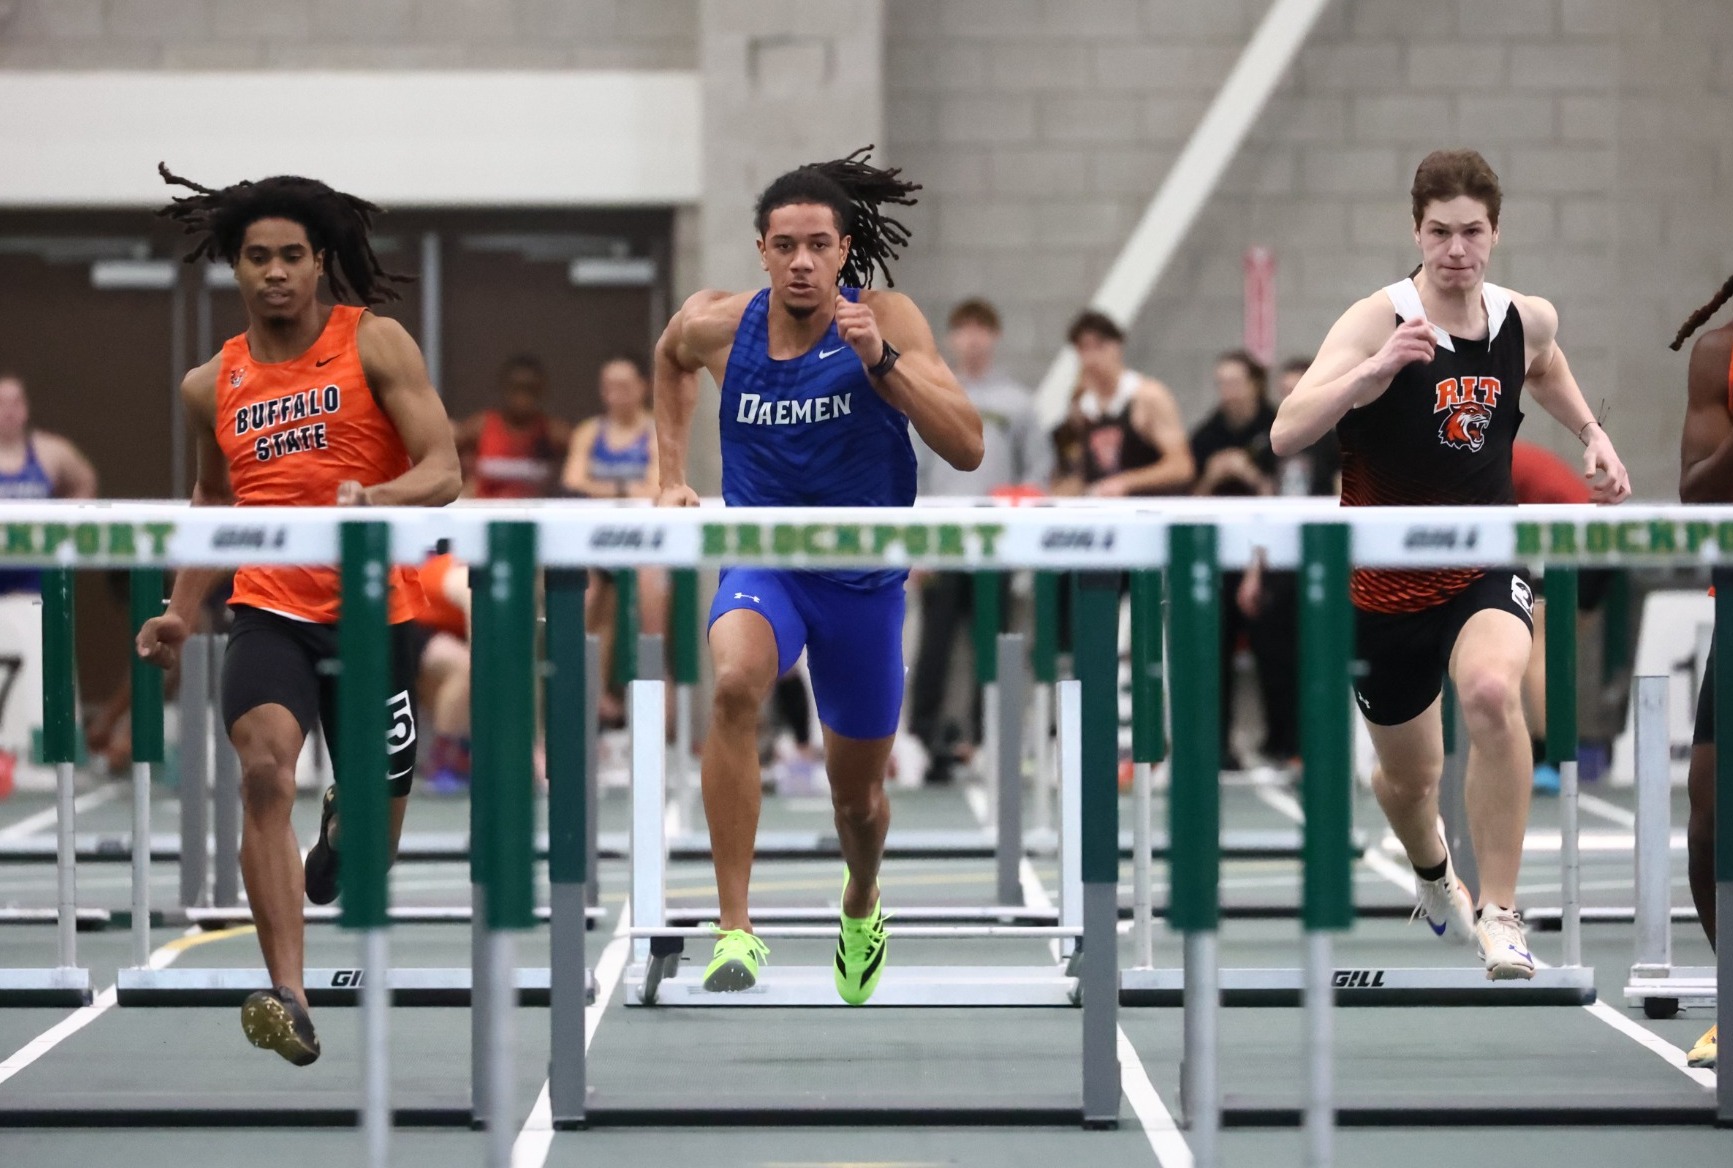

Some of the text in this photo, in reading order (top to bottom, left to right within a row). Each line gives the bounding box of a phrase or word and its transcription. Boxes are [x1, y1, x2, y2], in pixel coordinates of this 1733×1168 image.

[235, 384, 340, 436] BUFFALO
[736, 392, 852, 426] DAEMEN
[1433, 376, 1501, 414] RIT
[254, 422, 328, 462] STATE
[702, 521, 1005, 556] BROCKPORT
[384, 696, 413, 747] 5
[331, 969, 365, 987] GI
[1331, 970, 1385, 987] GILL
